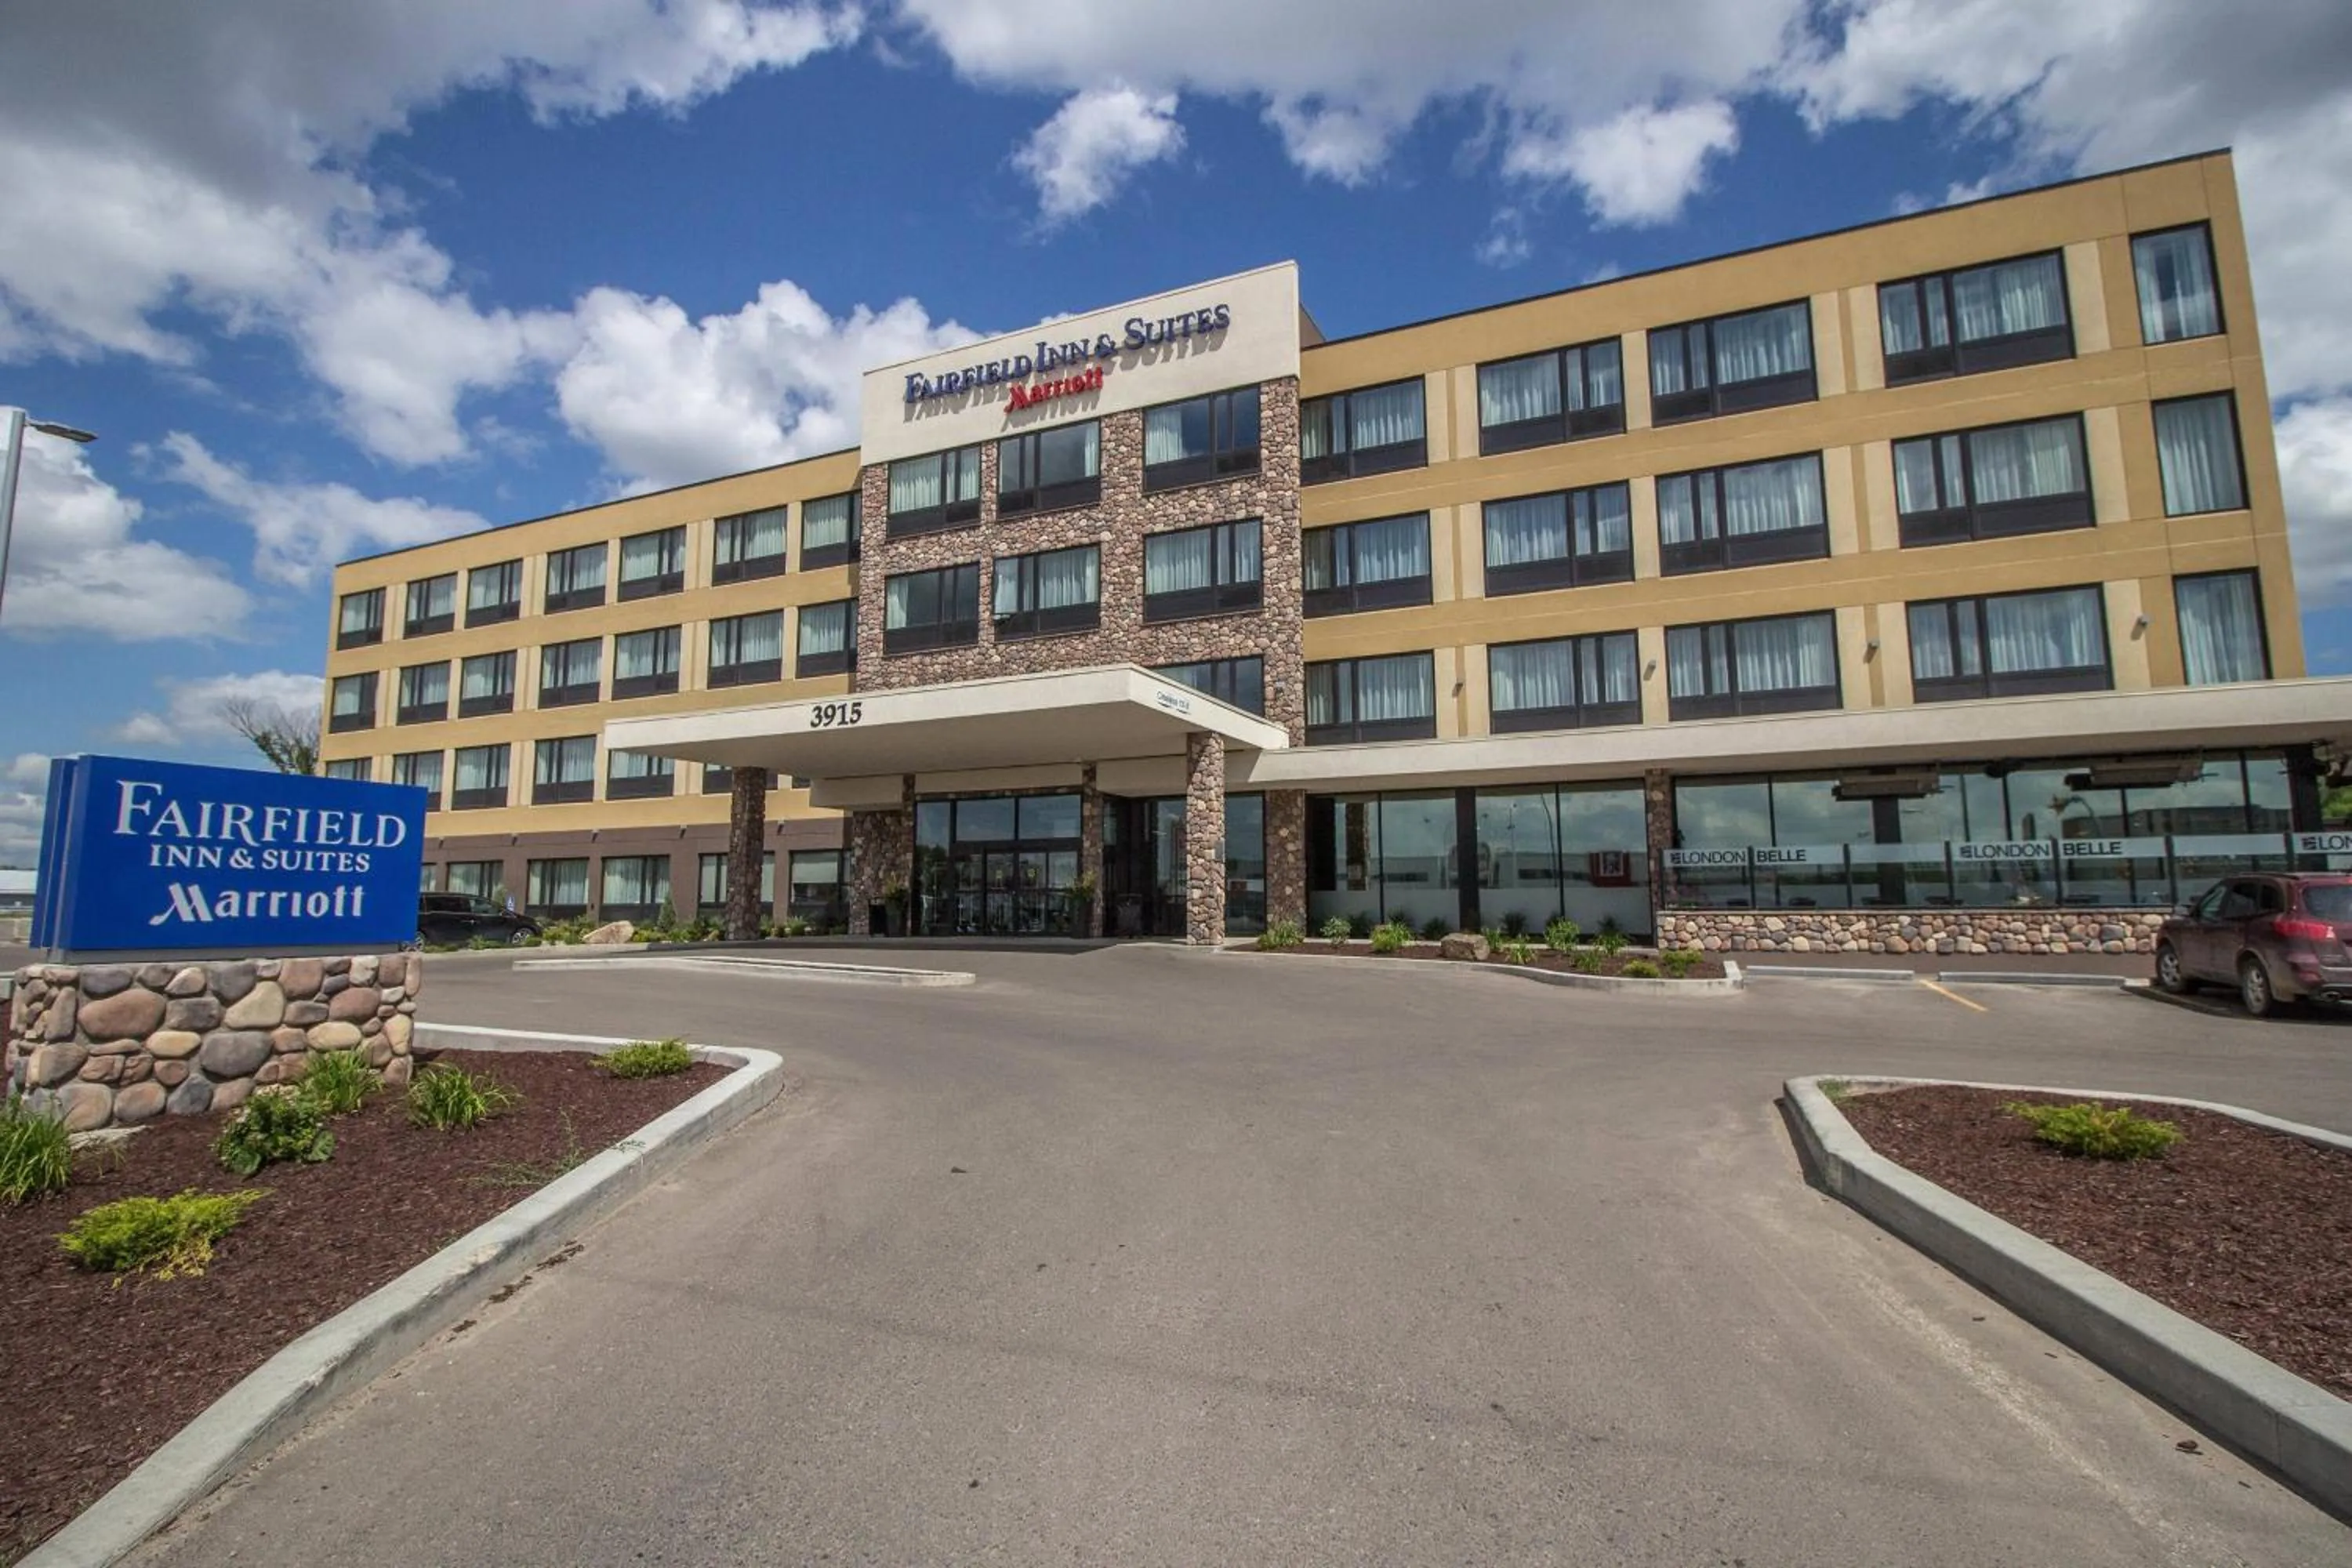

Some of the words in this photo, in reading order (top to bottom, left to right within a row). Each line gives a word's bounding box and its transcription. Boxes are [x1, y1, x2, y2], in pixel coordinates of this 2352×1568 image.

[904, 354, 1033, 404] FAIRFIELD
[1036, 339, 1090, 372] INN
[1094, 333, 1119, 358] &
[1123, 303, 1230, 350] SUITES
[1004, 364, 1103, 414] Marriott
[810, 702, 862, 728] 3915
[113, 779, 406, 848] FAIRFIELD
[150, 844, 222, 869] INN
[229, 848, 255, 869] &
[262, 849, 371, 873] SUITES
[1682, 851, 1746, 863] LONDON
[1756, 849, 1807, 862] BELLE
[1973, 844, 2049, 858] LONDON
[2063, 841, 2122, 855] BELLE
[149, 882, 365, 926] Marriott
